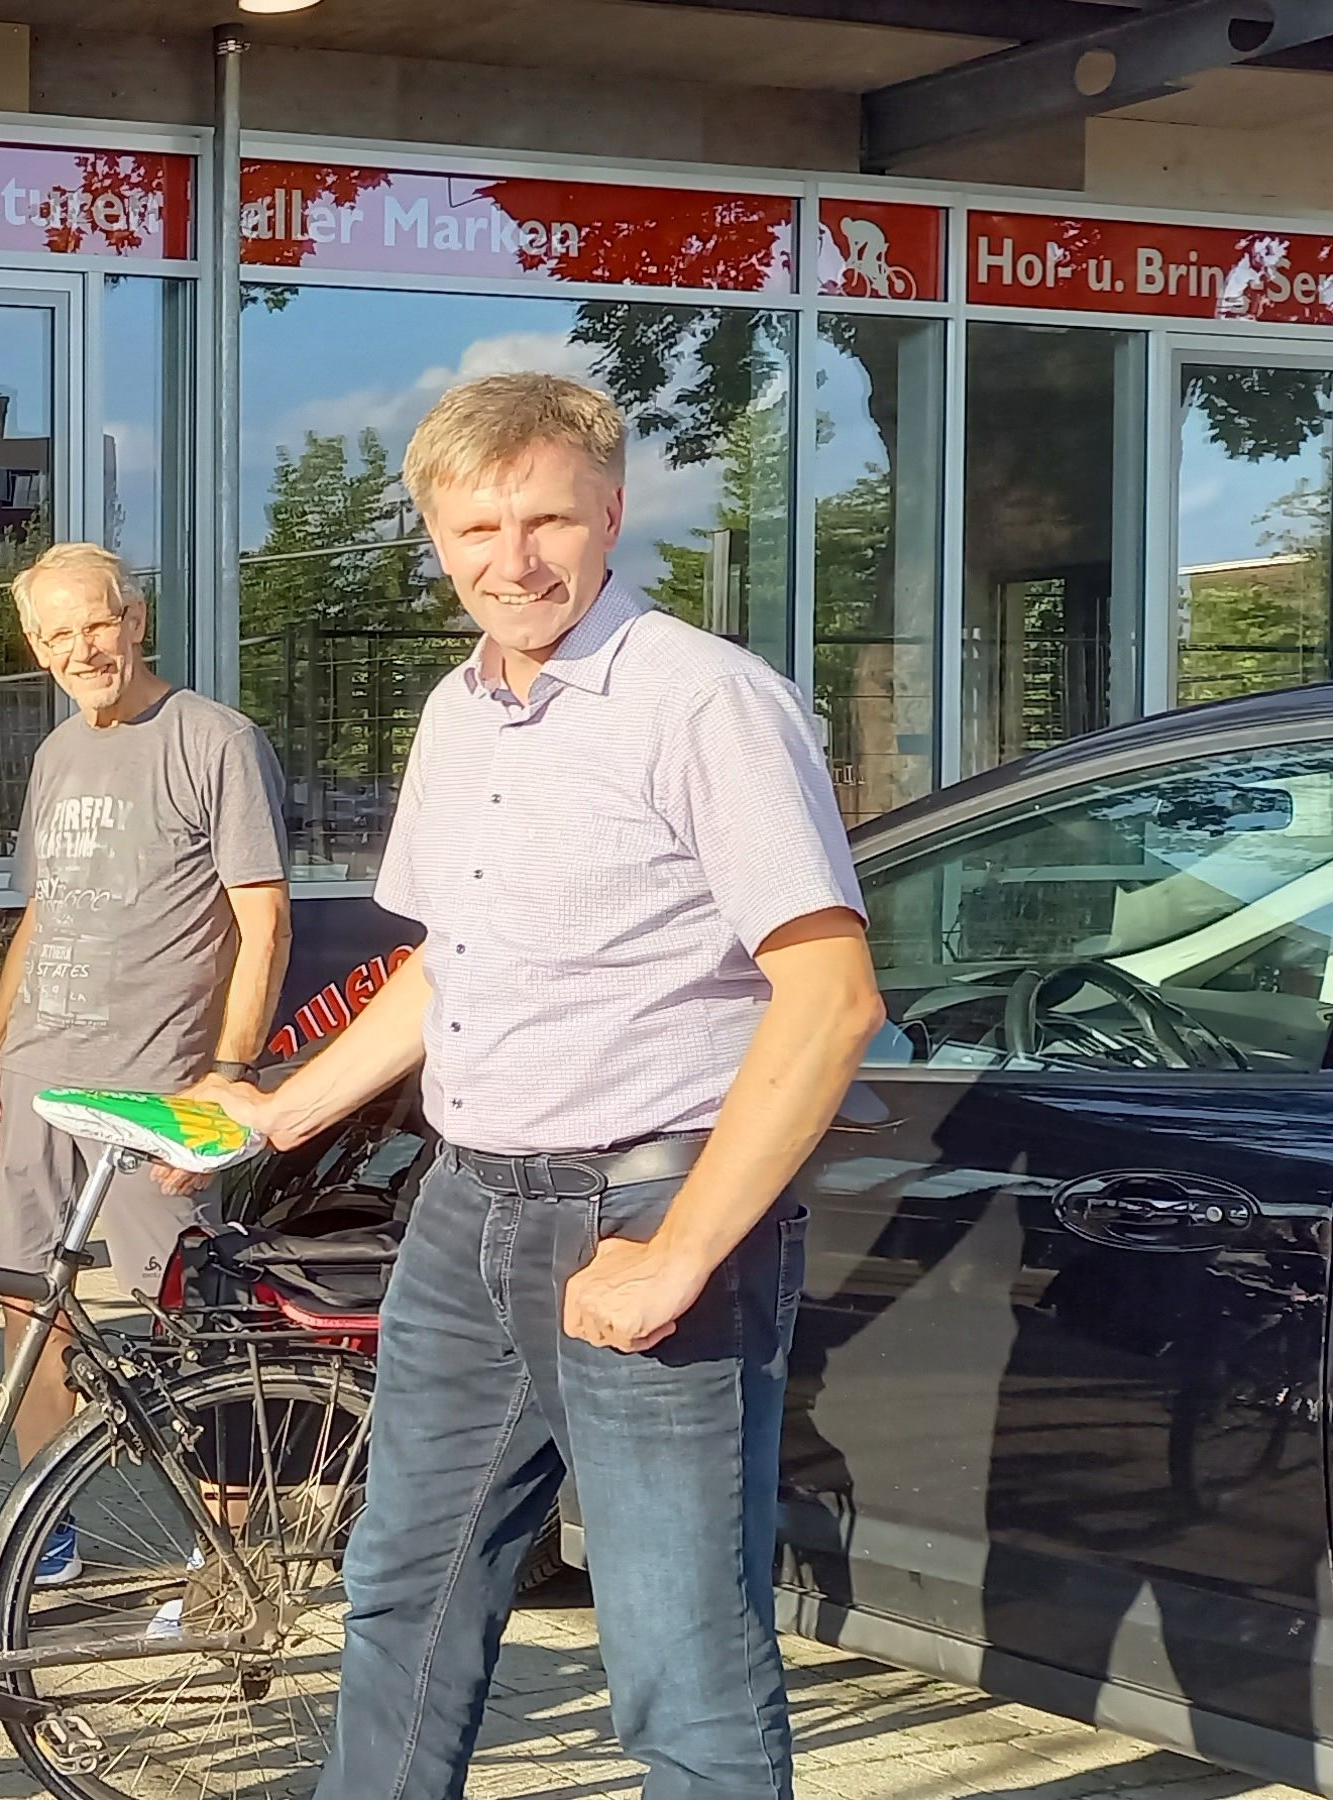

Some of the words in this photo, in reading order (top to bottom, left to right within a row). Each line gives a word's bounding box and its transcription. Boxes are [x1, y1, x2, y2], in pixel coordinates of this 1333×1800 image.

[241, 188, 364, 245] aller
[383, 194, 580, 258] Marken
[1088, 256, 1125, 293] u.
[37, 962, 90, 978] STATES
